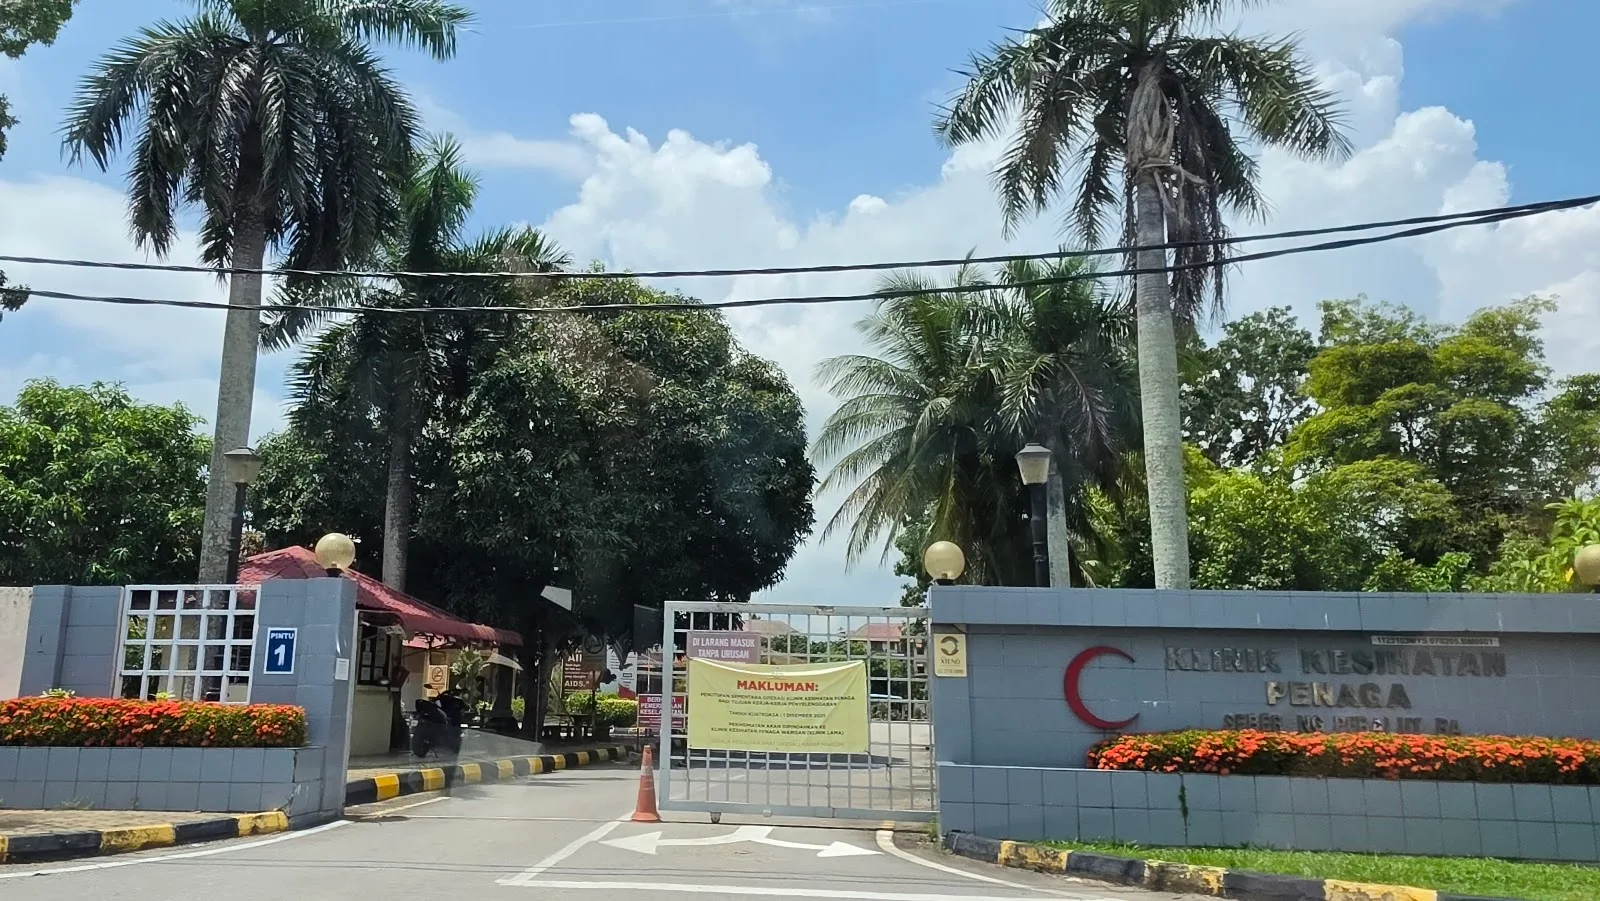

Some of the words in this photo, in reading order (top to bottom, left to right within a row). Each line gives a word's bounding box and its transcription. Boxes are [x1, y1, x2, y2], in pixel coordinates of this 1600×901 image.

[692, 638, 700, 646] DI
[701, 638, 729, 647] LARANG
[730, 638, 756, 648] MASUK
[274, 644, 286, 666] 1
[698, 649, 720, 658] TANPA
[721, 650, 750, 659] URUSAN
[1166, 647, 1282, 672] KLINIK
[1300, 648, 1507, 676] KESIHATAN
[736, 680, 819, 692] MAKLUMAN:
[1266, 680, 1412, 708] PENAGA
